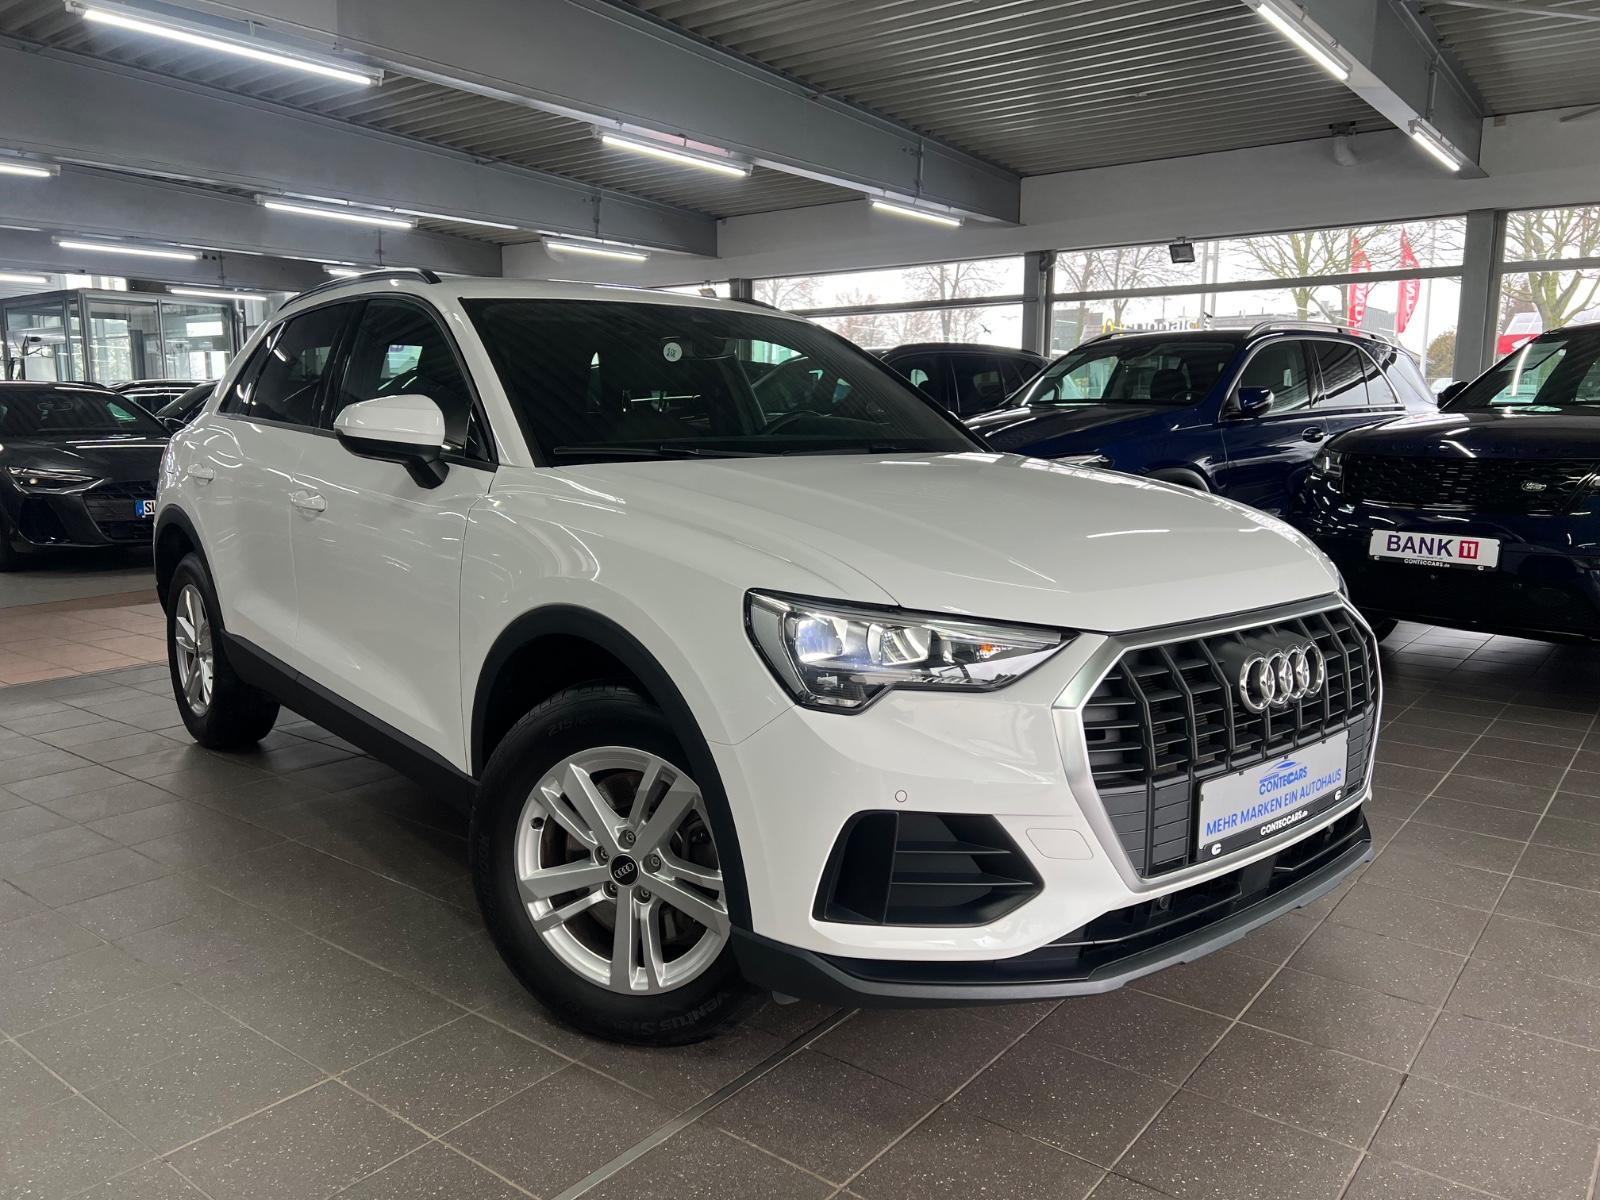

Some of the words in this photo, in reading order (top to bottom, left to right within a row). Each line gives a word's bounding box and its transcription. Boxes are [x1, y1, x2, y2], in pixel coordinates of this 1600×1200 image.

[1386, 534, 1455, 557] BANK
[1404, 558, 1450, 568] CONTECCARS.de
[1206, 813, 1238, 837] MEHR
[1240, 796, 1282, 825] MARKEN
[1284, 791, 1298, 807] EIN
[1300, 768, 1342, 800] AUTOHAUS
[1260, 810, 1308, 836] CONTECCARS.de
